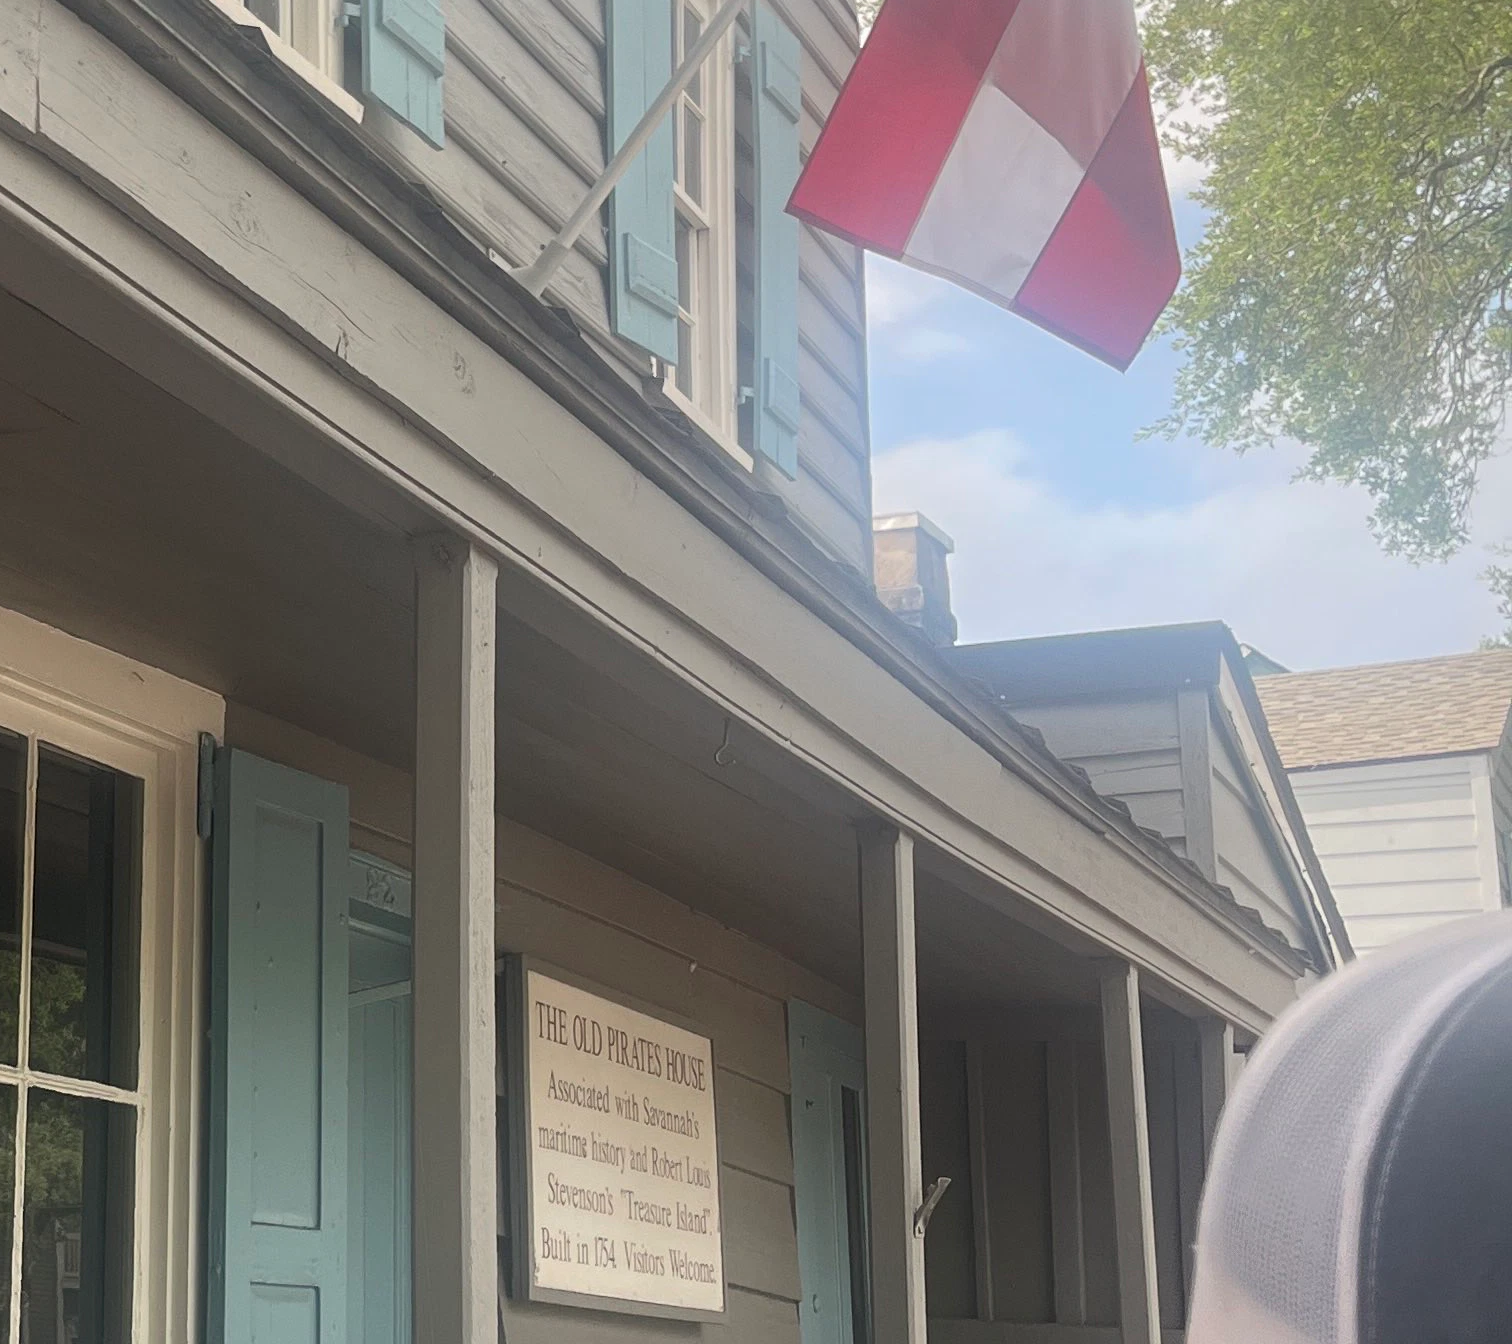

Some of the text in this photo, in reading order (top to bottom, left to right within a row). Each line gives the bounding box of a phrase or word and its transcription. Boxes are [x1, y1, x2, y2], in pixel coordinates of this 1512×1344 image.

[535, 1000, 706, 1092] THE OLD PIRATES HOUSE
[547, 1068, 700, 1140] Associated with Savannah's
[538, 1122, 711, 1189] maritime history and Robert Louis
[547, 1171, 614, 1216] Stevenson's
[620, 1188, 672, 1228] "Treasure
[541, 1226, 572, 1263] Built
[576, 1232, 589, 1265] in
[623, 1240, 665, 1277] Visitors
[668, 1248, 717, 1284] Welcome.
